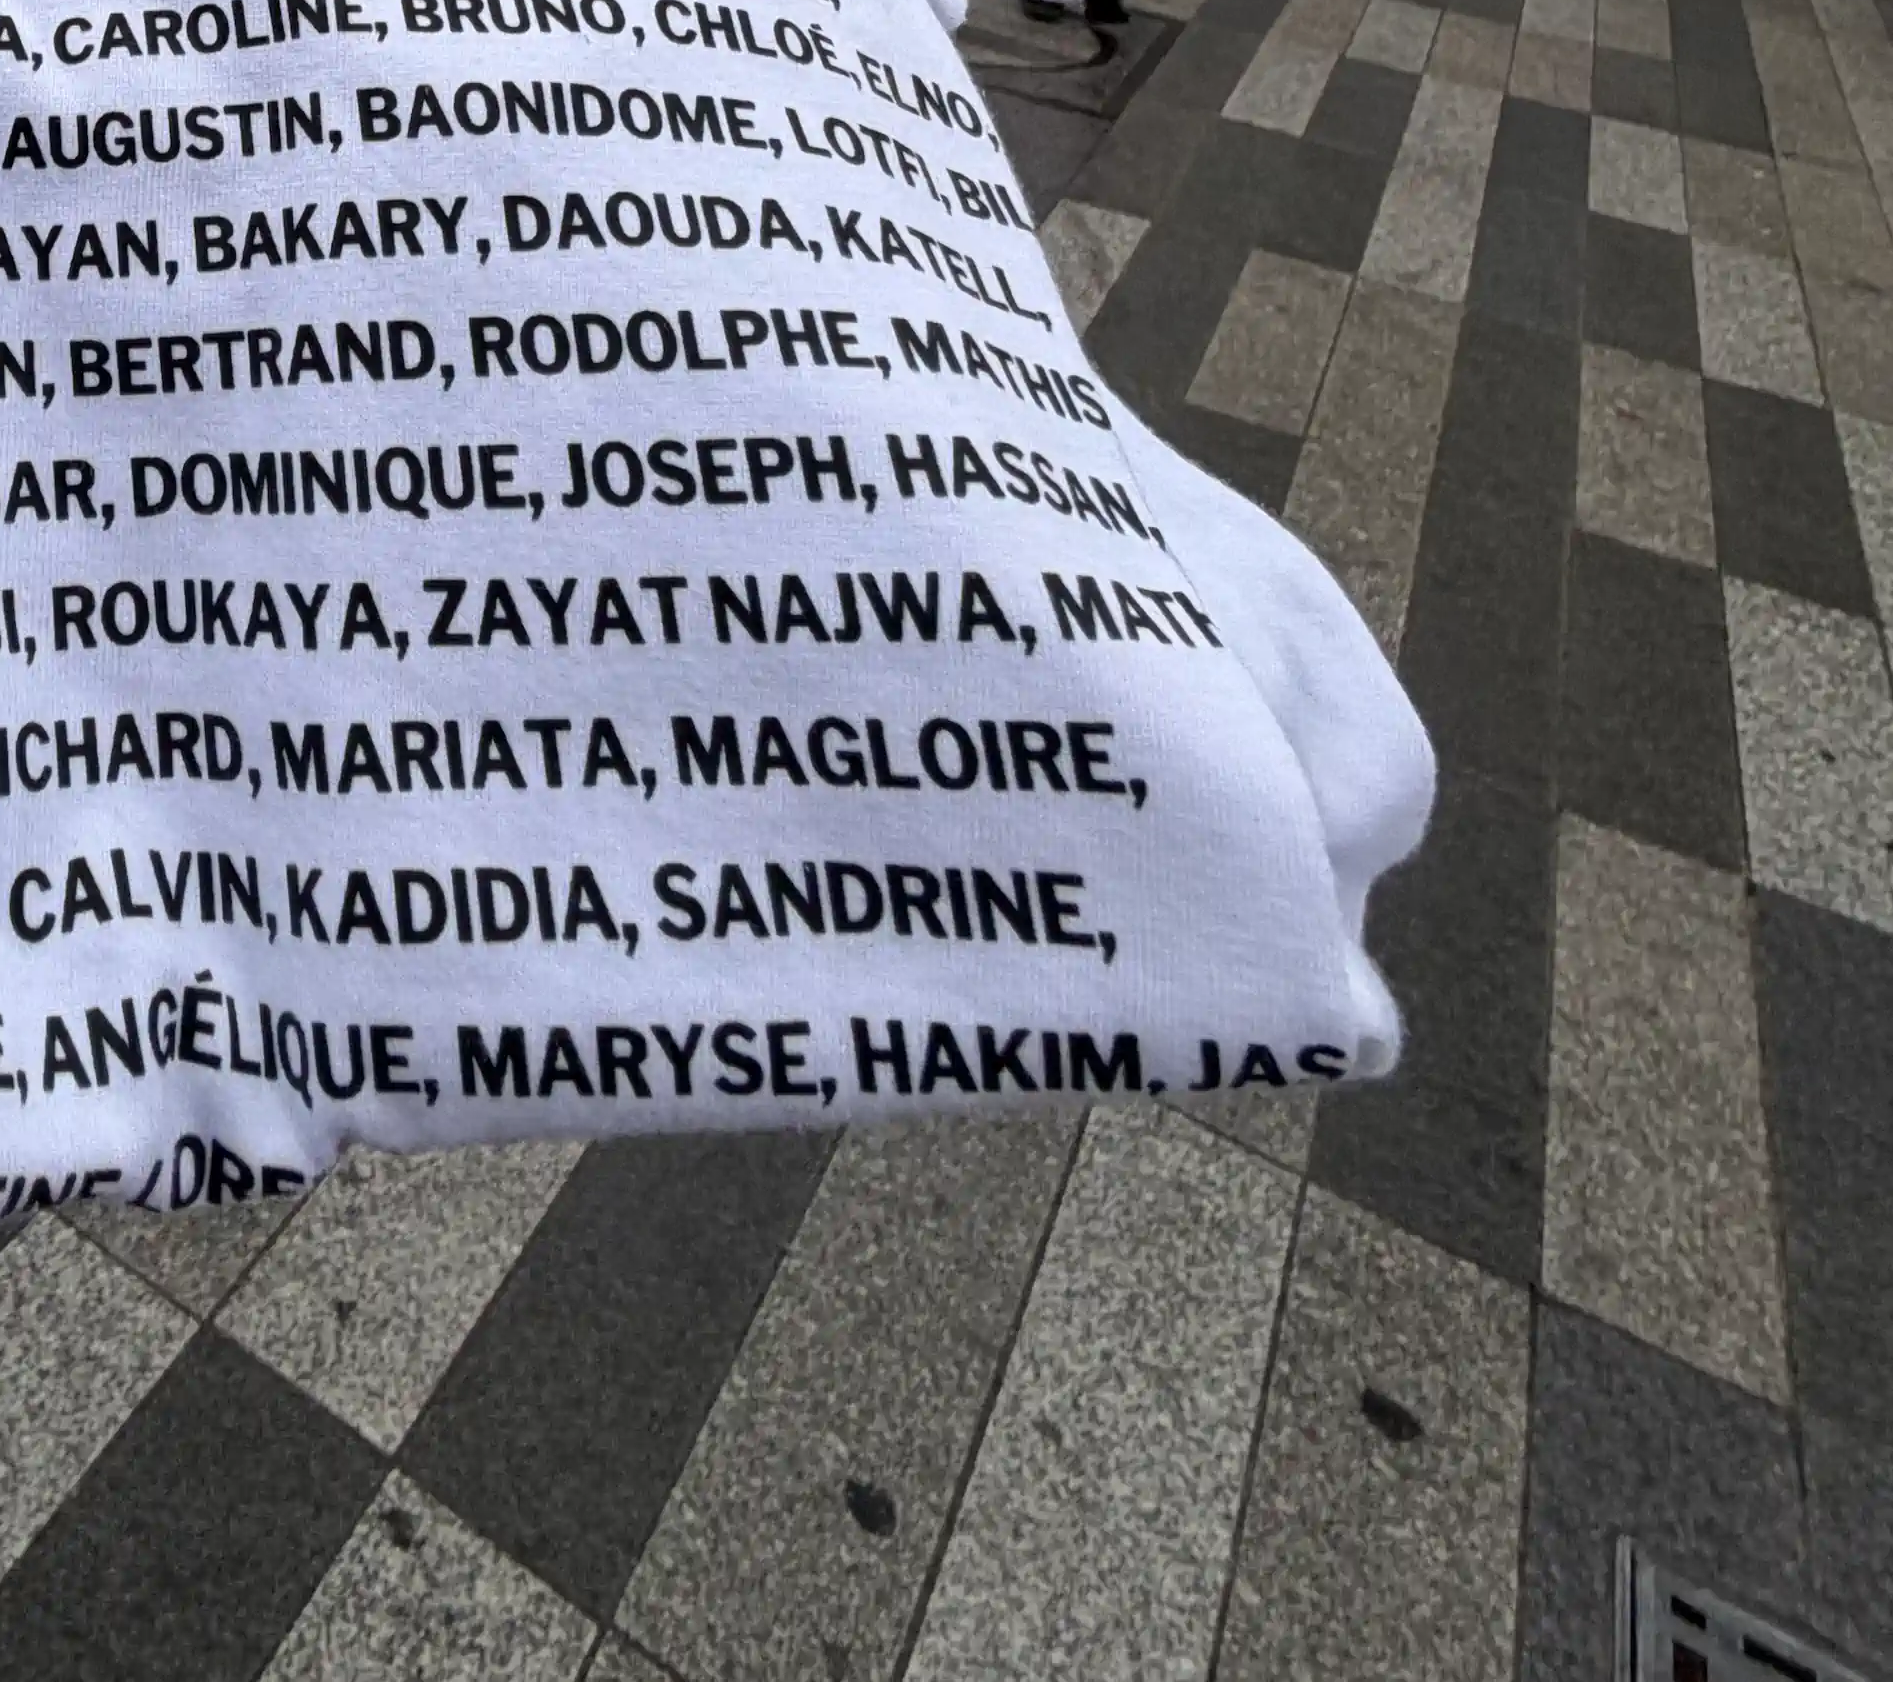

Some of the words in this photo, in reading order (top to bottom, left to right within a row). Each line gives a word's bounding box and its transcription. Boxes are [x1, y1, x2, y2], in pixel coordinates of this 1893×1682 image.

[2, 91, 343, 171] AUGUSTIN,
[356, 81, 783, 159] BAONIDOME,
[785, 106, 952, 216] LOTFI,
[193, 196, 491, 273] BAKARY,
[503, 192, 823, 263] DAOUDA,
[824, 204, 1052, 333] KATELL,
[69, 320, 455, 397] BERTRAND,
[469, 309, 891, 379] RODOLPHE,
[131, 444, 545, 521] DOMINIQUE,
[562, 435, 878, 514] JOSEPH,
[886, 434, 1166, 552] HASSAN,
[52, 579, 410, 662] ROUKAYA,
[422, 576, 688, 648] ZAYAT
[708, 571, 1037, 657] NAJWA,
[270, 717, 657, 801] MARIATA,
[671, 715, 1147, 810] MAGLOIRE,
[9, 848, 277, 945] CALVIN,
[286, 864, 639, 957] KADIDIA,
[653, 861, 1117, 965] SANDRINE,
[43, 969, 440, 1111] ANGÉLIQUE,
[457, 1020, 837, 1109] MARYSE,
